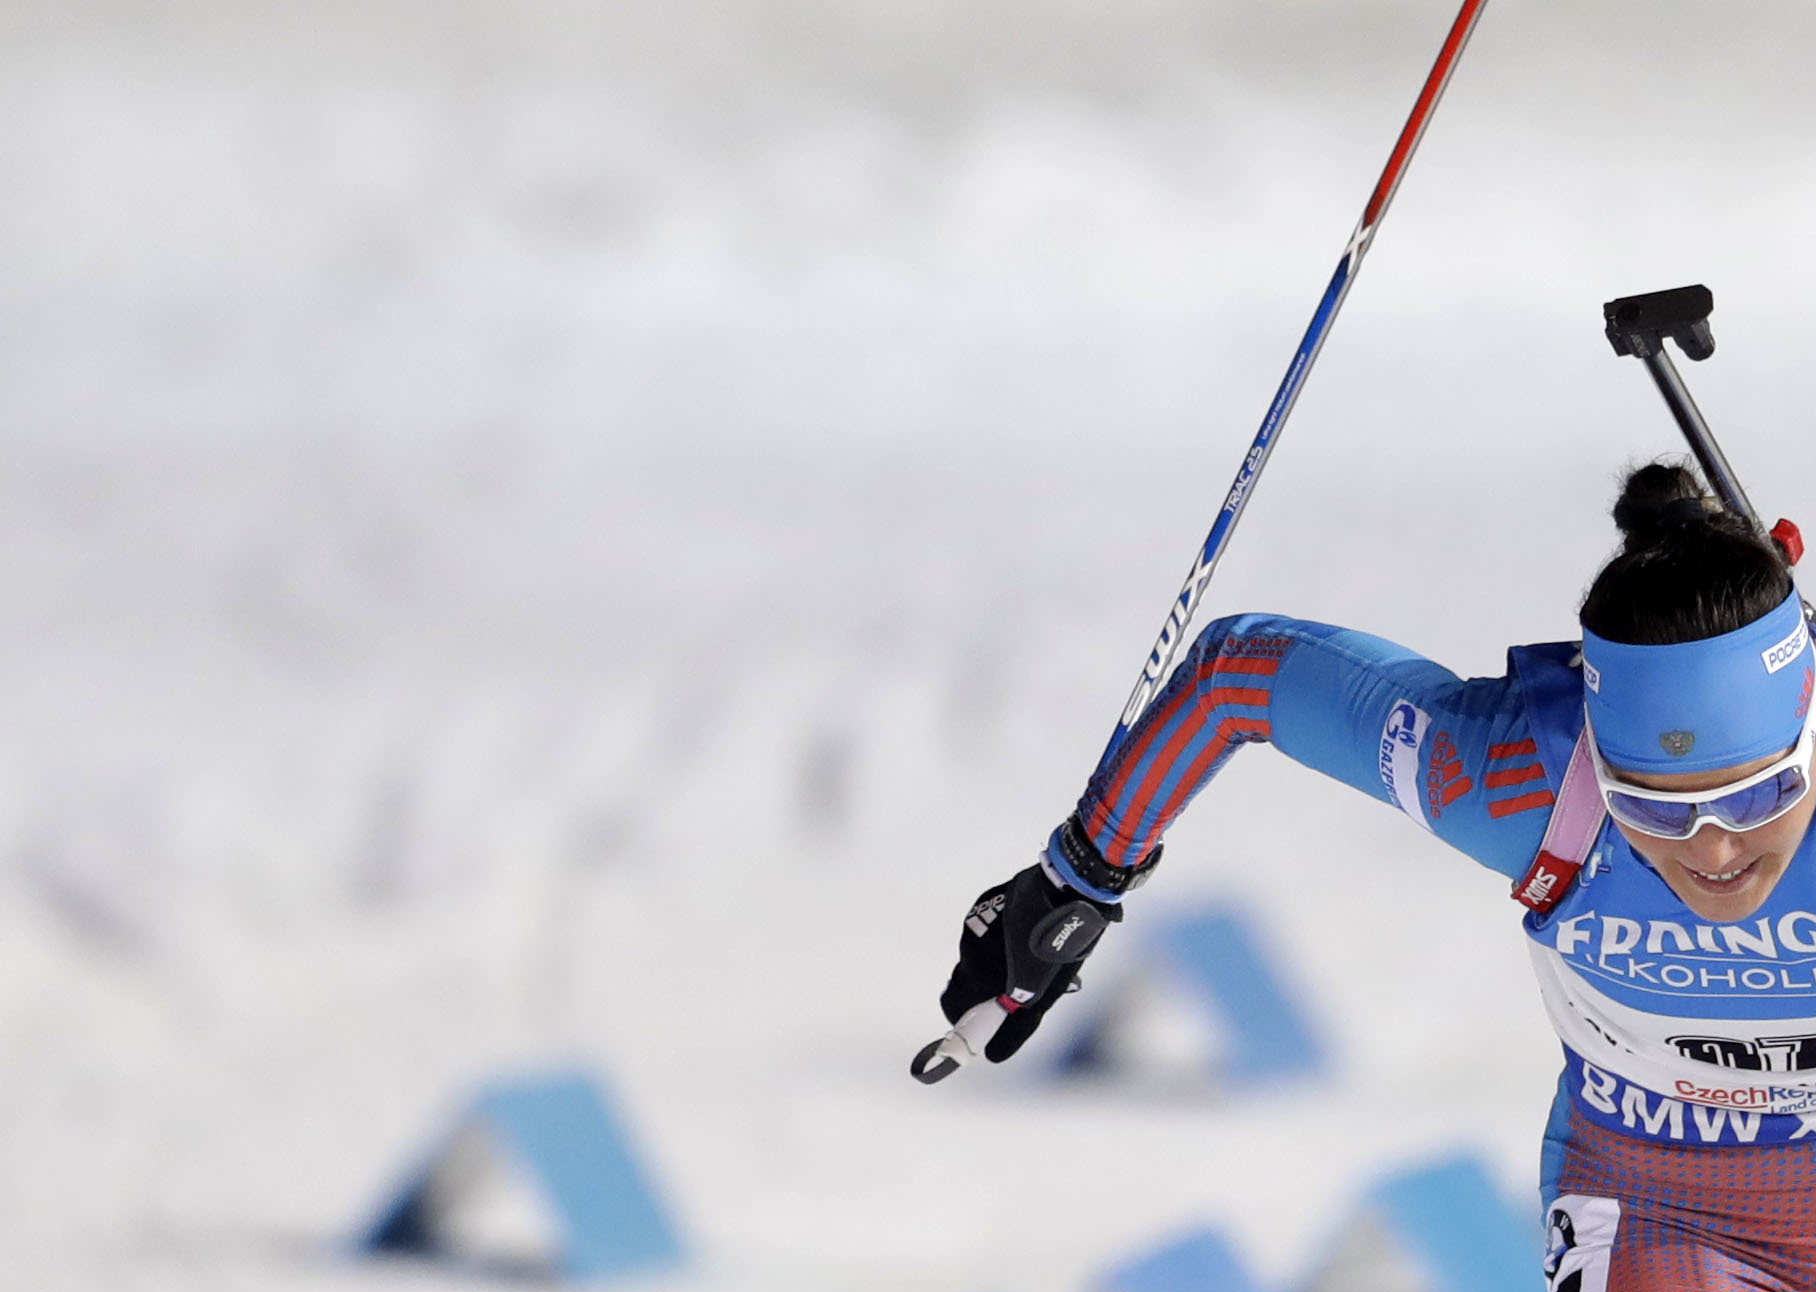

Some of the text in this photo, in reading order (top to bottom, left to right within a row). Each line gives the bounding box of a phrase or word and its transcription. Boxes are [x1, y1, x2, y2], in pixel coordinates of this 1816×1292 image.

[1223, 469, 1251, 513] TRIAC
[1426, 731, 1450, 819] adidas
[1580, 1060, 1762, 1143] BMW
